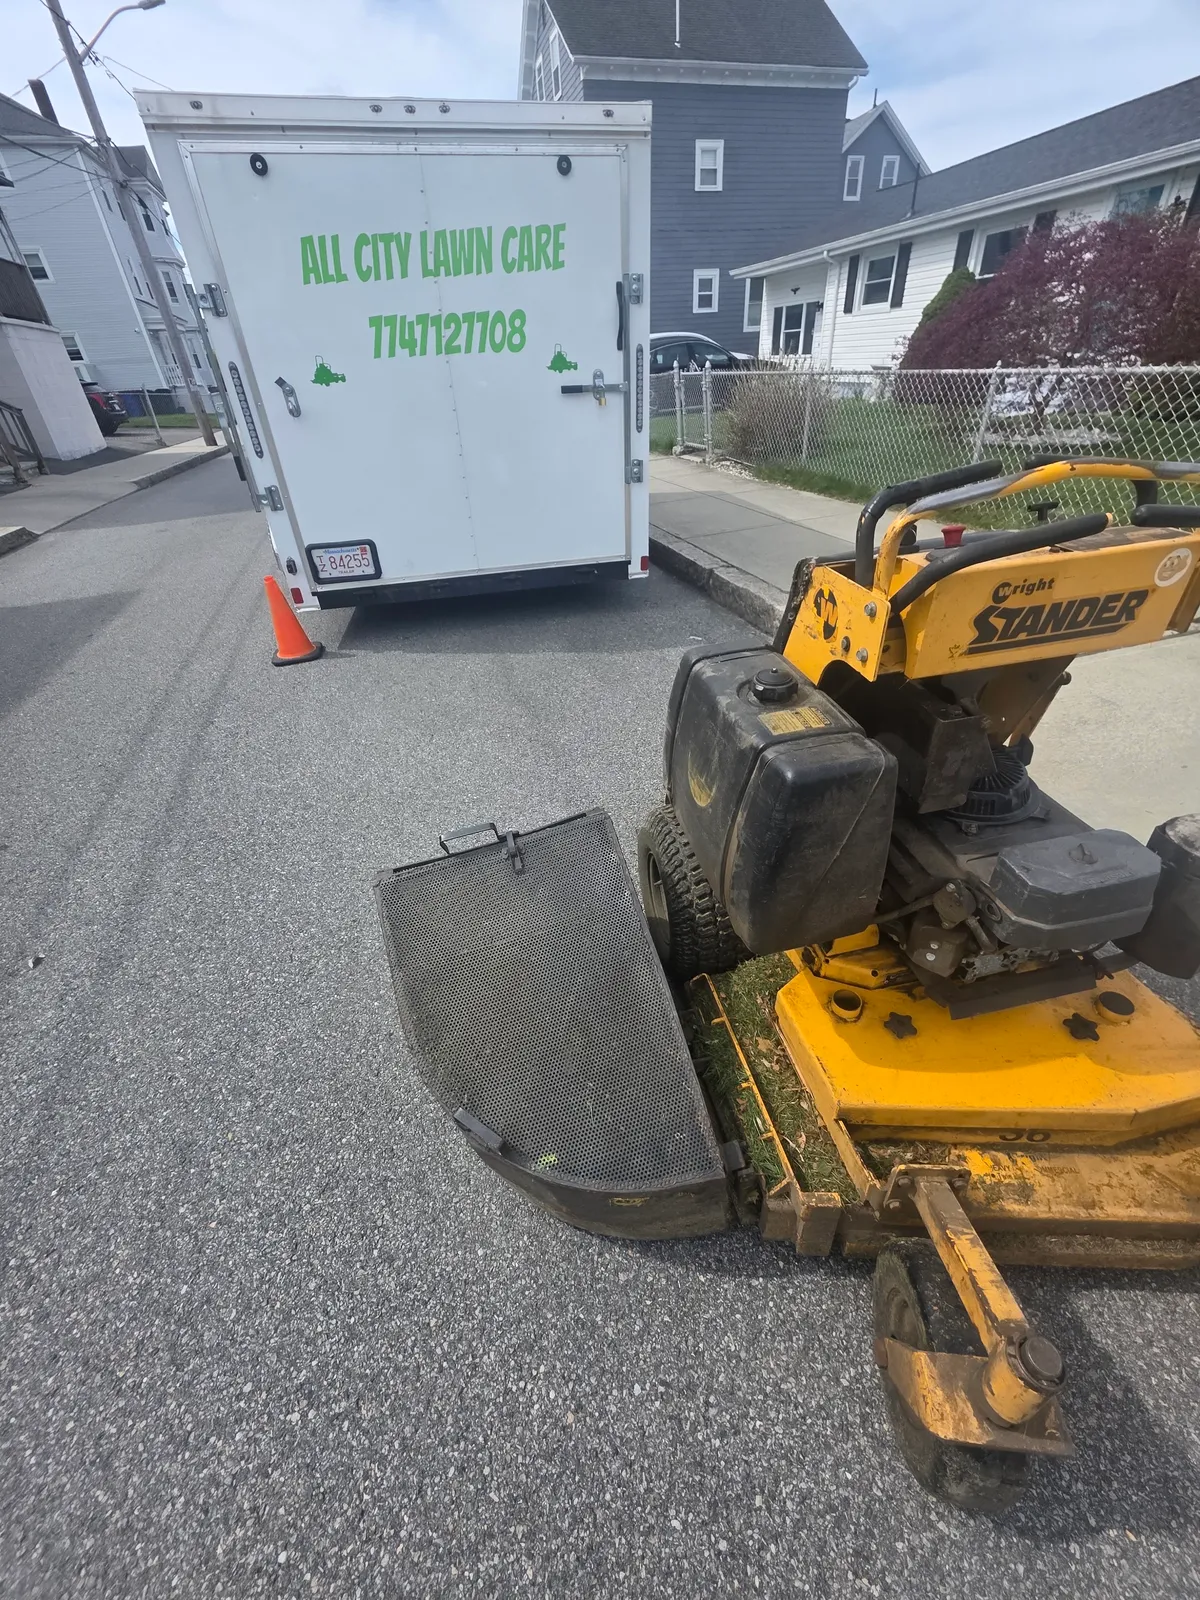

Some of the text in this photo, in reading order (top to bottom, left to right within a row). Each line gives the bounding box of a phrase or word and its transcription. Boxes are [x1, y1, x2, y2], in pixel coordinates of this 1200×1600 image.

[300, 222, 567, 285] ALL CITY LAWN CARE
[368, 308, 527, 359] 7747127708
[328, 553, 370, 570] 84255
[991, 577, 1056, 604] Wright
[967, 589, 1150, 646] STANDER
